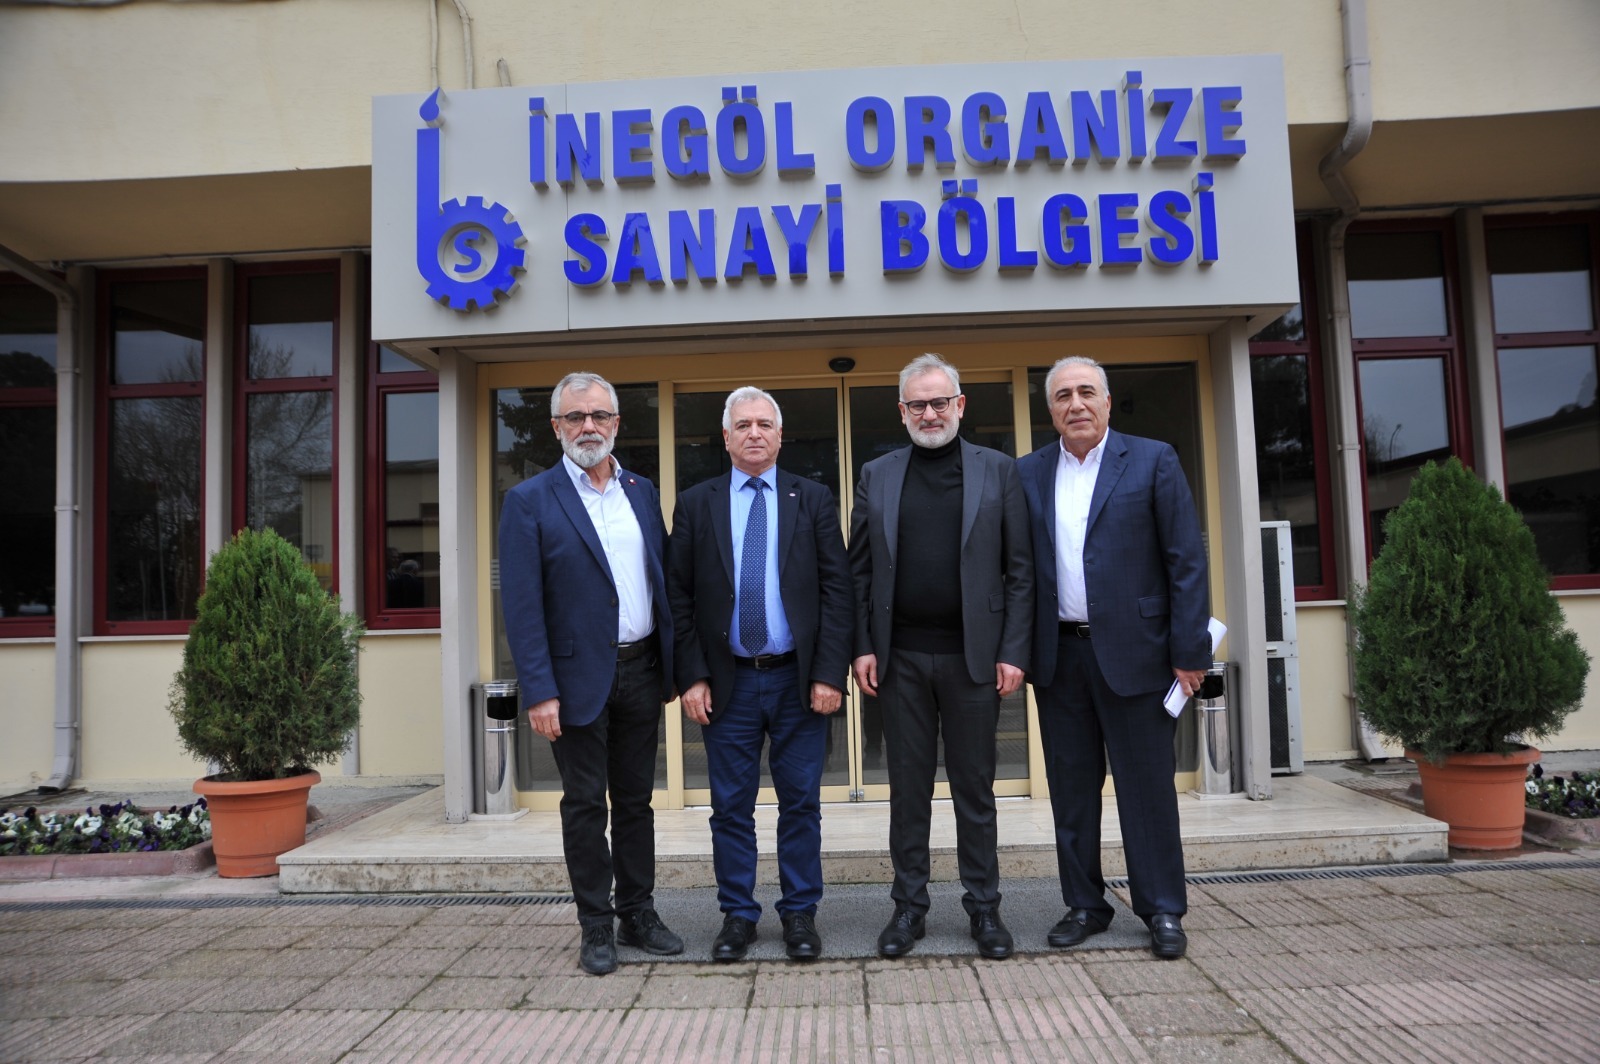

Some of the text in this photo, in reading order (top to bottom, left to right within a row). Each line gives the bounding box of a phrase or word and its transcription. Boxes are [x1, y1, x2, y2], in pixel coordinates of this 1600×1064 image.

[529, 71, 1247, 183] İNEGÖL ORGANİZE
[563, 172, 1219, 286] SANAYİ BÖLGESİ
